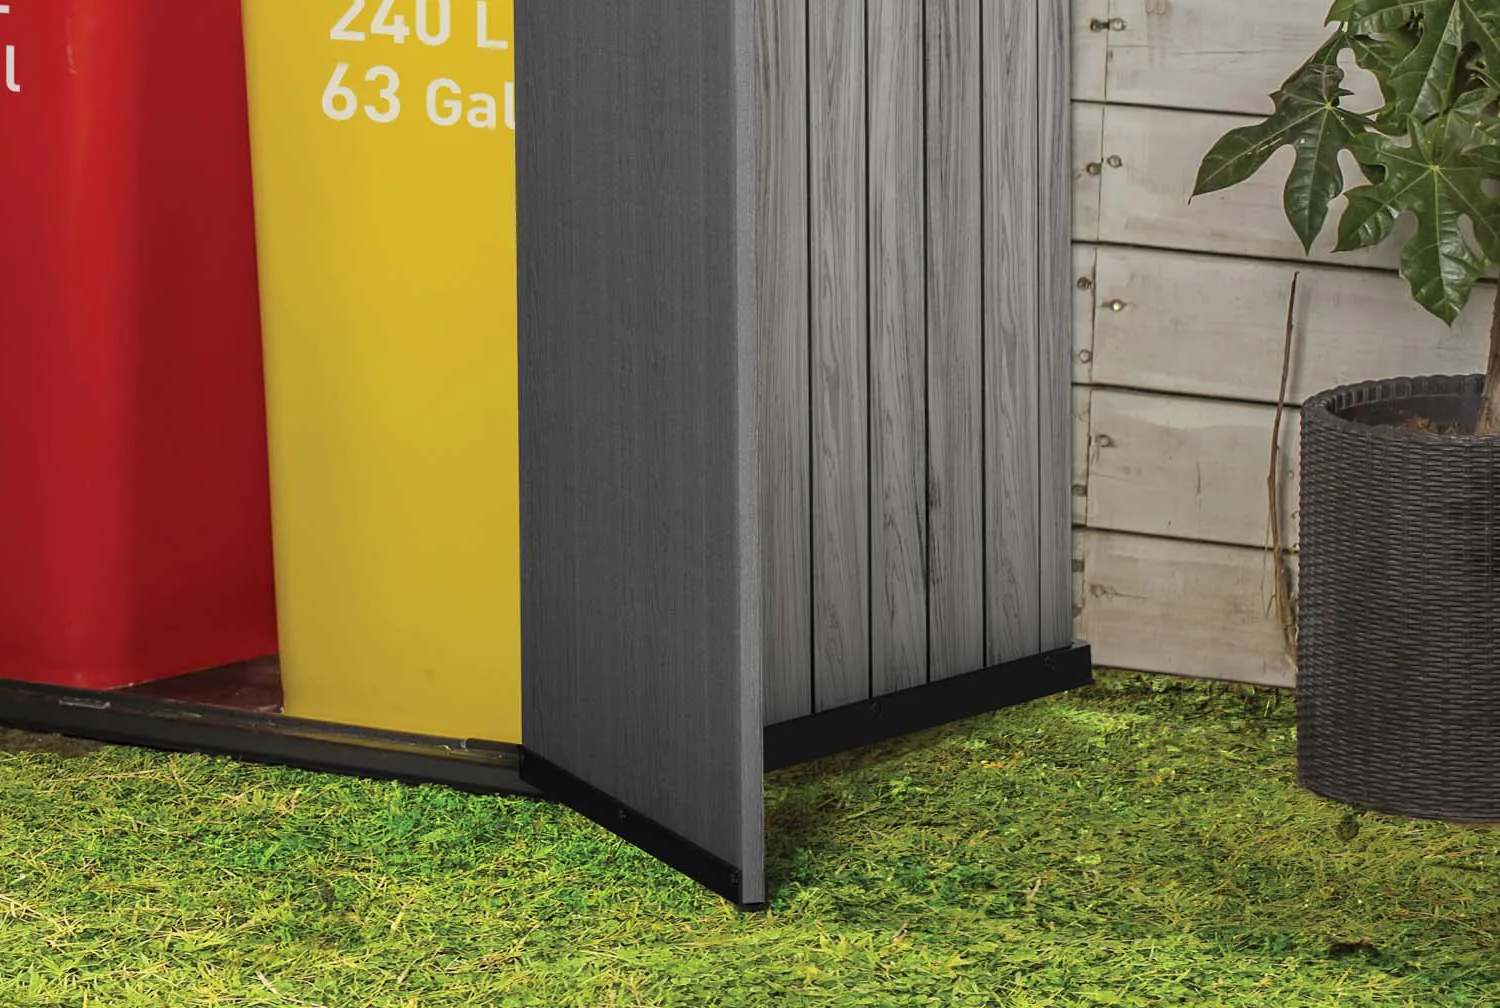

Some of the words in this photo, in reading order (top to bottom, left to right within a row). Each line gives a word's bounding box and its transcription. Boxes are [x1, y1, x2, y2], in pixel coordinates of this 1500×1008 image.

[476, 0, 509, 50] L
[321, 61, 401, 124] 63
[425, 78, 516, 131] Gal
